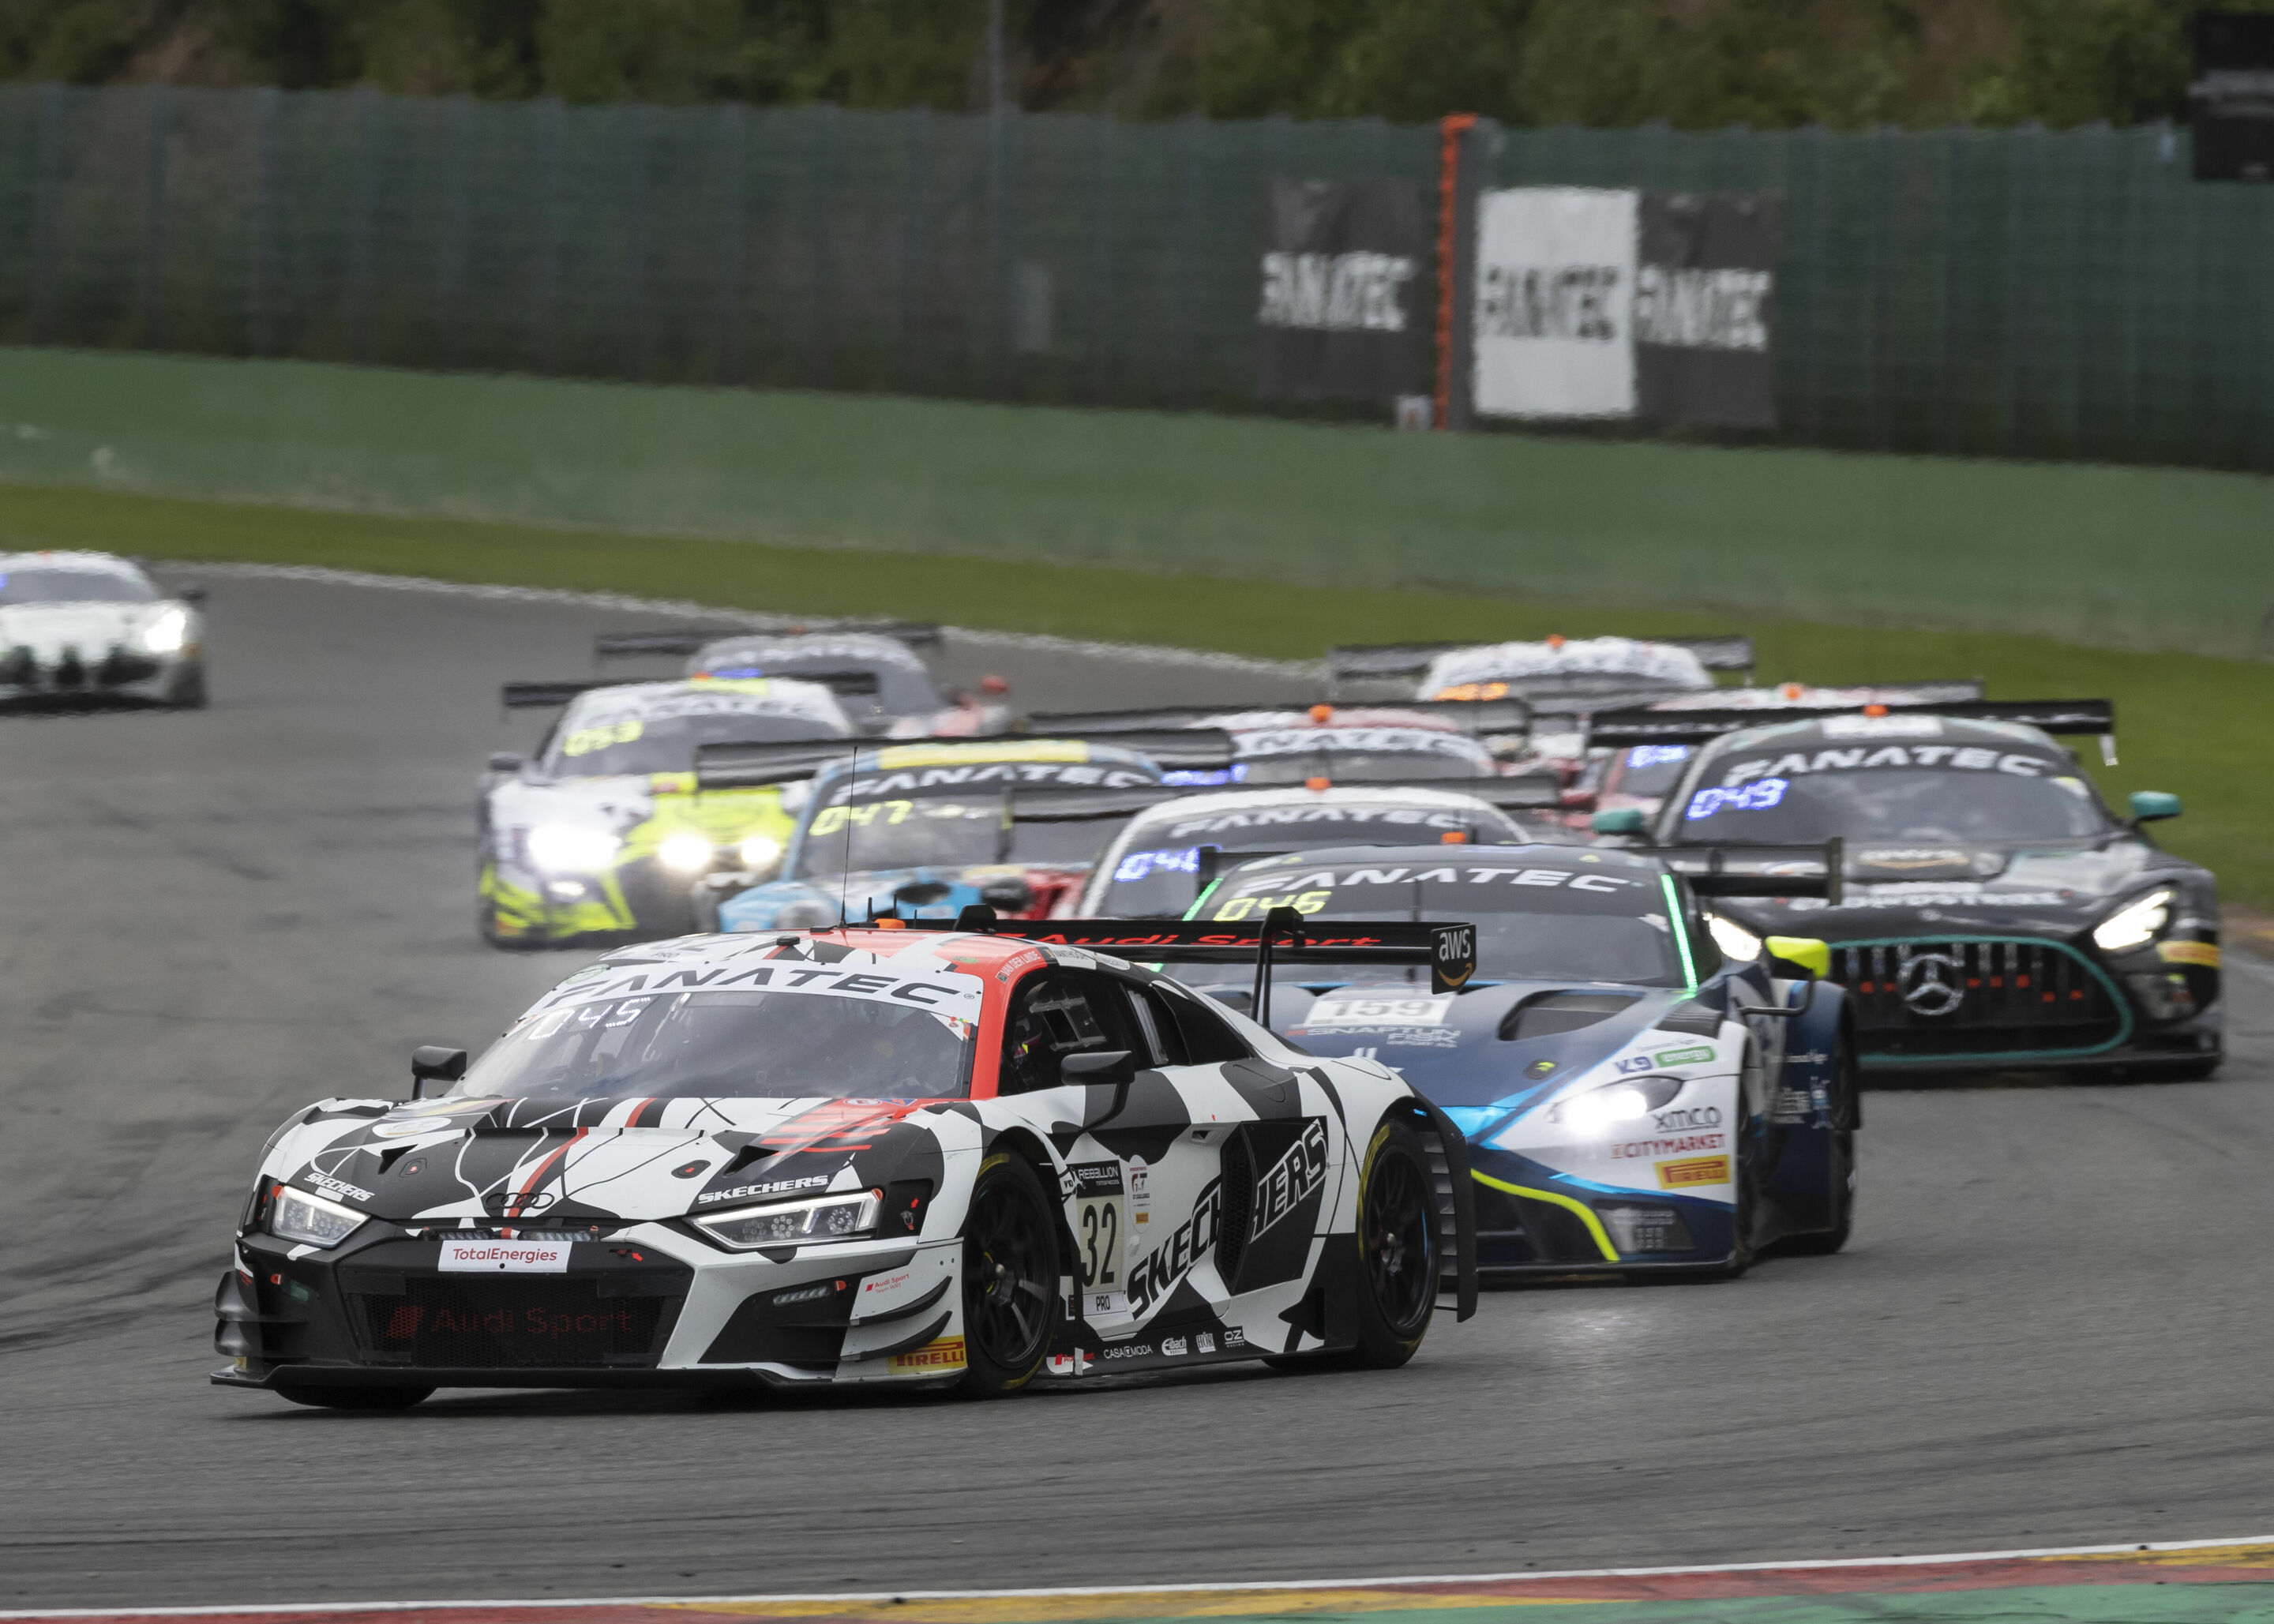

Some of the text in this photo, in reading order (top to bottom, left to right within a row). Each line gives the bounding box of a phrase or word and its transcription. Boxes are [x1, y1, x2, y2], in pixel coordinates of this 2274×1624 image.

[1724, 745, 2043, 788] FANATEC
[828, 764, 1154, 806] FANATEC
[809, 800, 913, 836] 047
[1168, 808, 1469, 839] FANATEC
[1233, 868, 1630, 898] FANATEC
[1036, 933, 1178, 946] Audi
[1439, 928, 1471, 962] aws
[1001, 963, 1014, 977] VAN
[1010, 956, 1025, 970] DER
[542, 967, 962, 1009] FANATEC
[1330, 1000, 1434, 1016] 159
[304, 1172, 375, 1202] SKECHERS
[1078, 1166, 1119, 1180] REBELLION
[698, 1175, 828, 1205] SKECHERS
[452, 1247, 558, 1264] TotalEnergies
[1081, 1202, 1116, 1288] 32
[874, 1273, 910, 1288] Audi Sport
[1095, 1295, 1111, 1311] PRO
[432, 1307, 634, 1340] Audi Sport
[896, 1340, 964, 1367] PIRELLI
